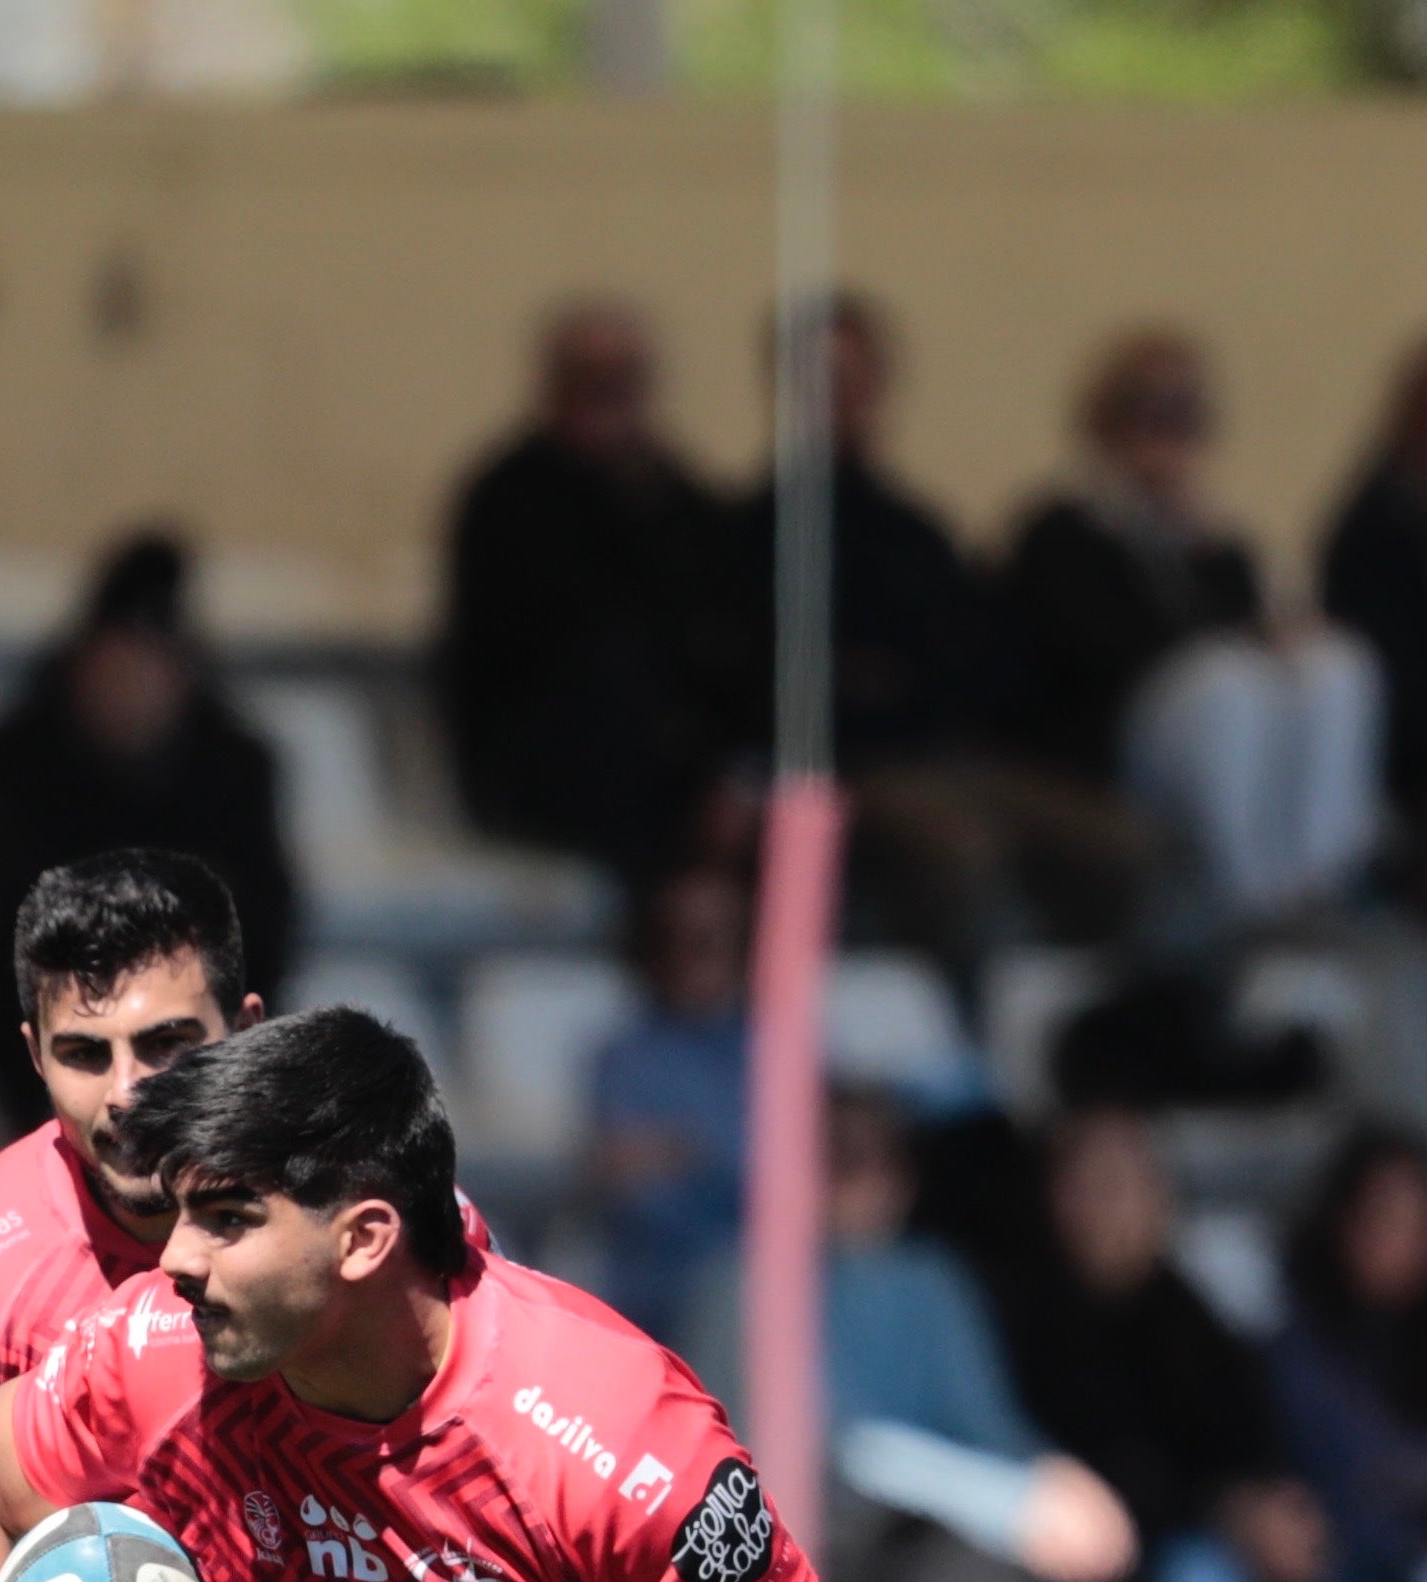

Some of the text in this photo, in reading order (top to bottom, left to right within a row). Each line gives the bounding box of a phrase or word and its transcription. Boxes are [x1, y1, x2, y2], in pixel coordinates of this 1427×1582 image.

[513, 1385, 617, 1480] dasilva
[307, 1536, 389, 1582] nb
[698, 1540, 731, 1580] de
